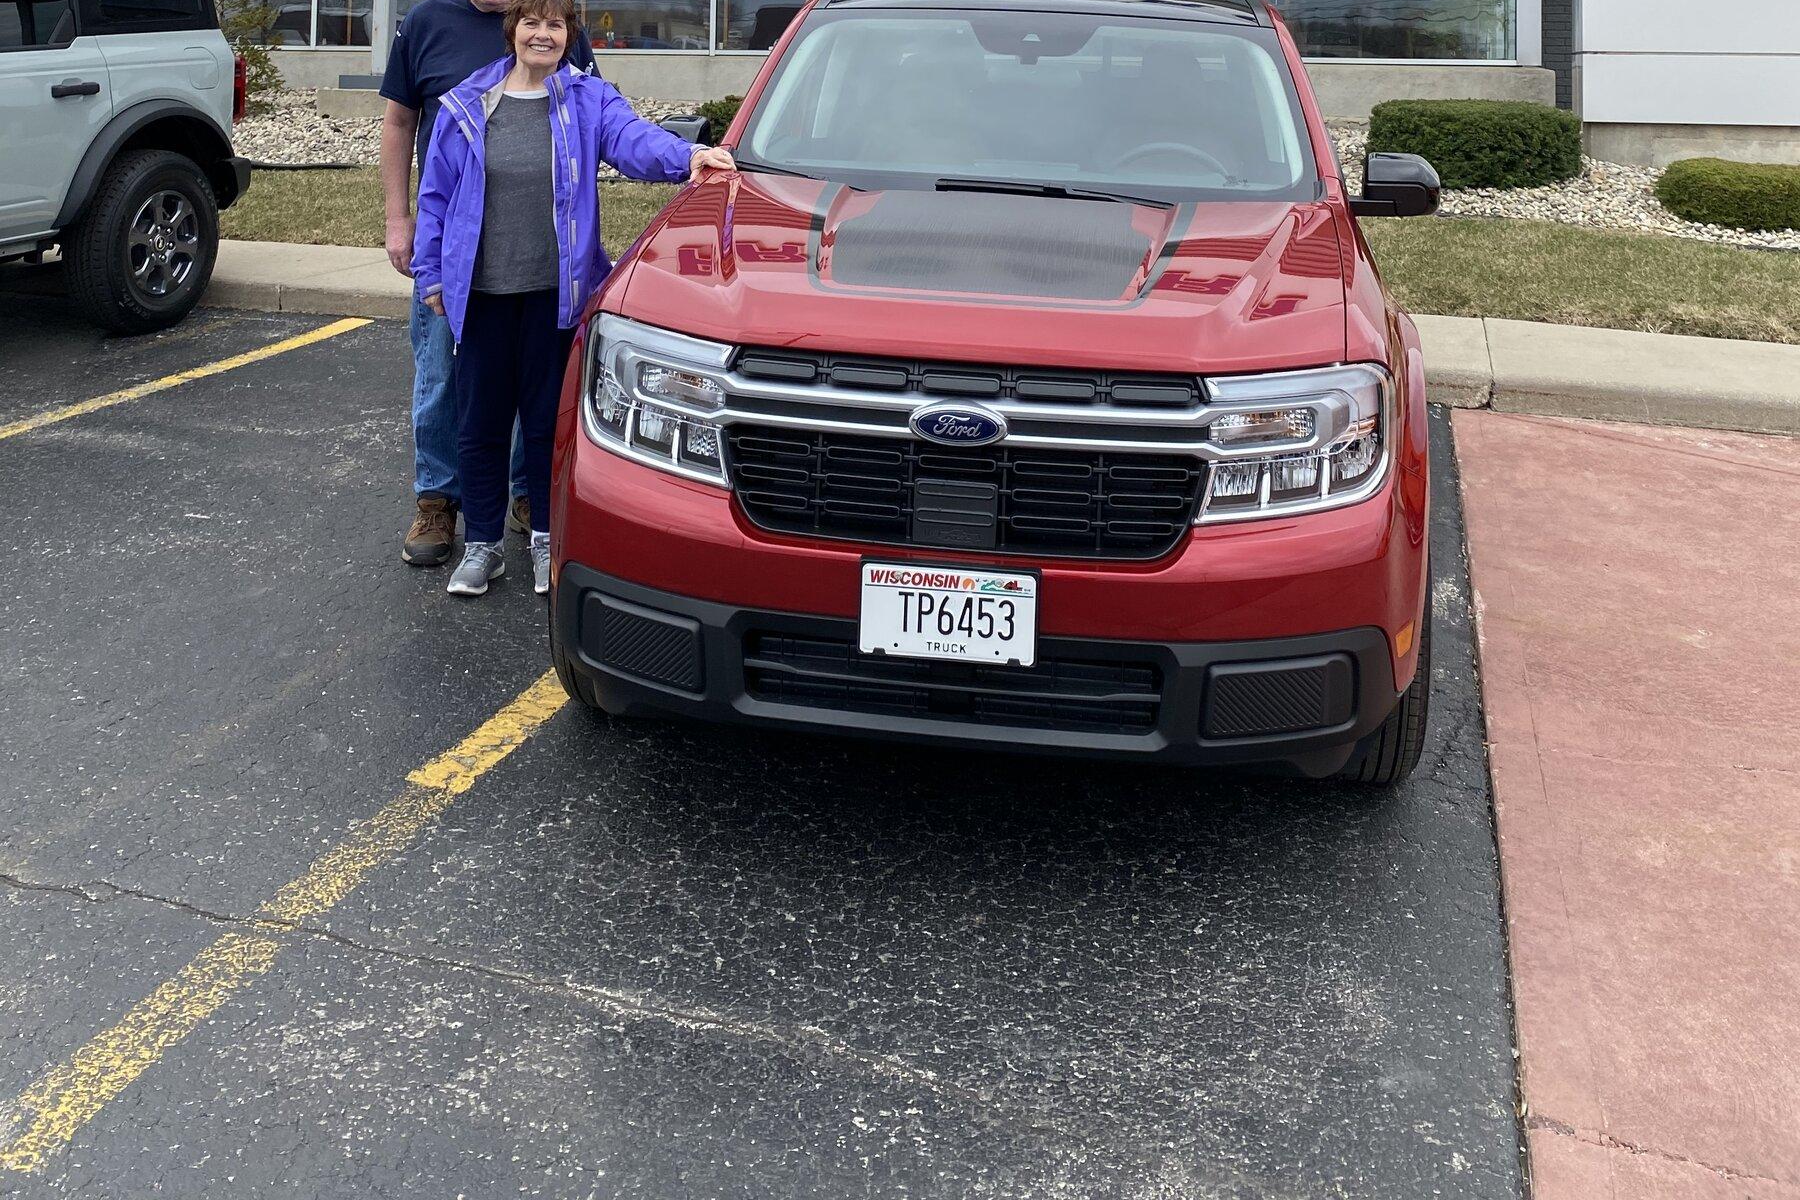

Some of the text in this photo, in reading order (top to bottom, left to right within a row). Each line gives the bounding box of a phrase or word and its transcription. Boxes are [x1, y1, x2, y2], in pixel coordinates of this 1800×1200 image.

[932, 413, 982, 439] Ford
[870, 569, 960, 589] WISCONSIN
[898, 590, 1016, 642] TP6453
[926, 641, 967, 654] TRUCK
